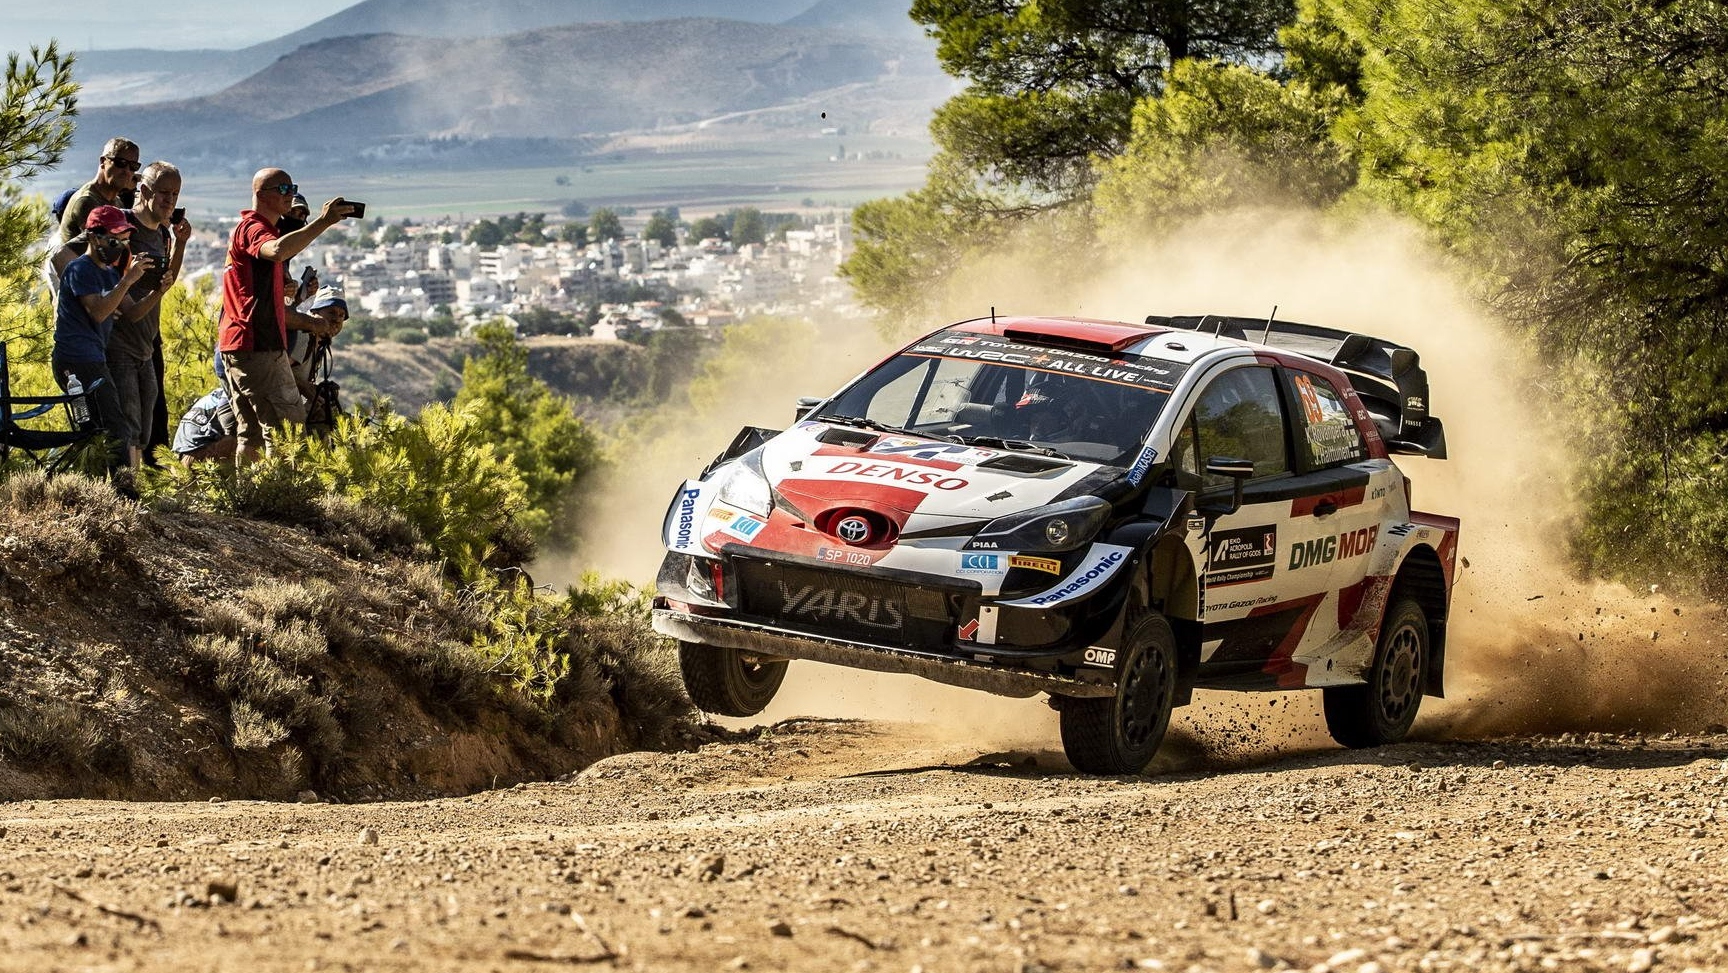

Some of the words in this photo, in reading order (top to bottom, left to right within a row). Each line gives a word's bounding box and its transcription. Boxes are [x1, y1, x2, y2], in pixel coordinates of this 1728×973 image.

[980, 340, 1046, 353] TOYOTA
[1047, 348, 1110, 363] GAZOO
[1110, 359, 1171, 376] Racing
[1047, 359, 1087, 374] ALL
[1091, 366, 1140, 383] LIVE
[1294, 374, 1324, 425] 69
[826, 461, 970, 491] DENSO
[675, 488, 701, 549] Panasonic
[825, 549, 843, 561] SP
[846, 552, 871, 566] 1020
[972, 541, 999, 549] PIAA
[1288, 535, 1338, 571] DMG
[1337, 523, 1381, 560] MOR
[968, 555, 989, 569] CCI
[1011, 556, 1058, 572] PIRELLI
[1031, 551, 1123, 606] Panasonic
[779, 580, 902, 629] YARIS
[1084, 649, 1116, 665] OMP
